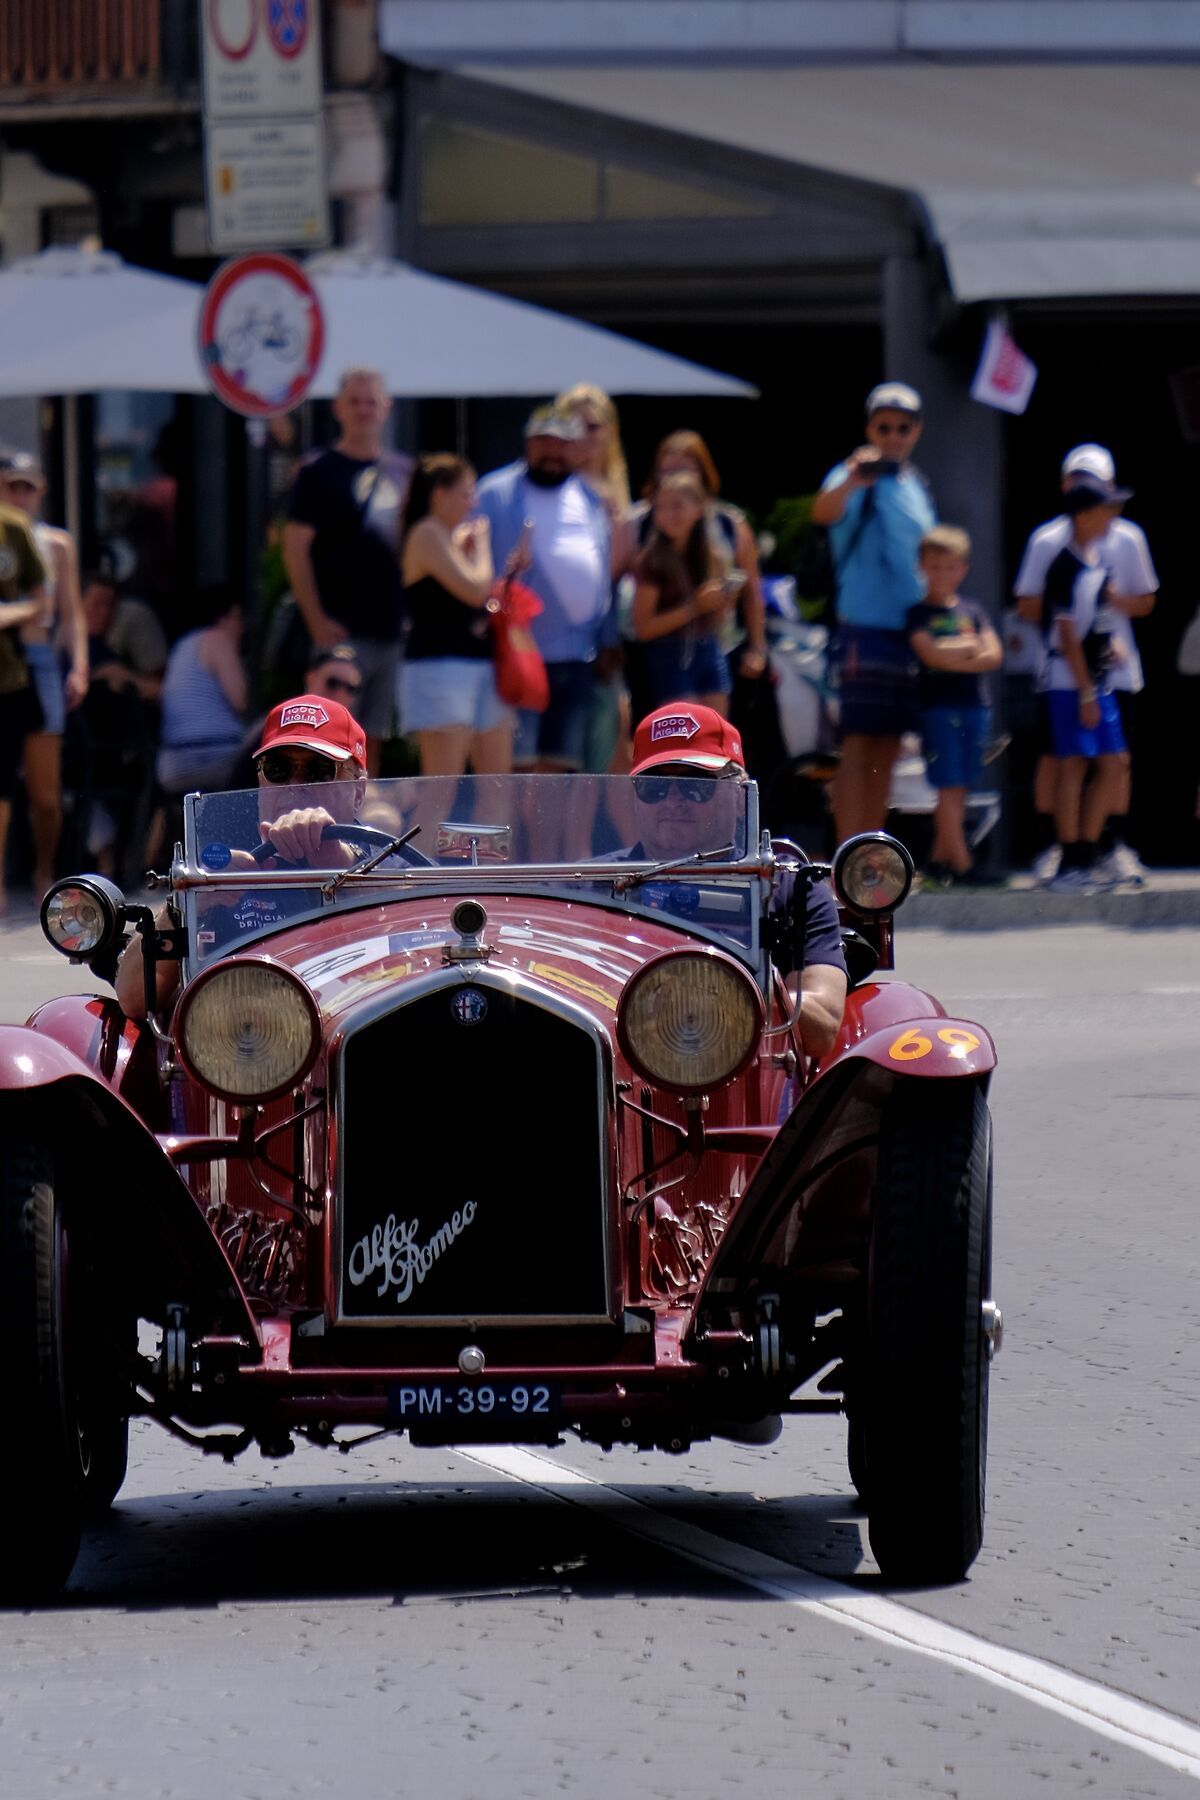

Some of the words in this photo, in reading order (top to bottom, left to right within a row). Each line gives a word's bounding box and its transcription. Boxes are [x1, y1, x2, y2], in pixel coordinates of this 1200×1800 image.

[286, 707, 316, 715] 1000
[284, 715, 317, 723] MIGLIA
[657, 719, 686, 728] 1000
[655, 727, 688, 738] MIGLIA
[888, 1028, 981, 1061] 69
[400, 1387, 550, 1414] PM-39-92
